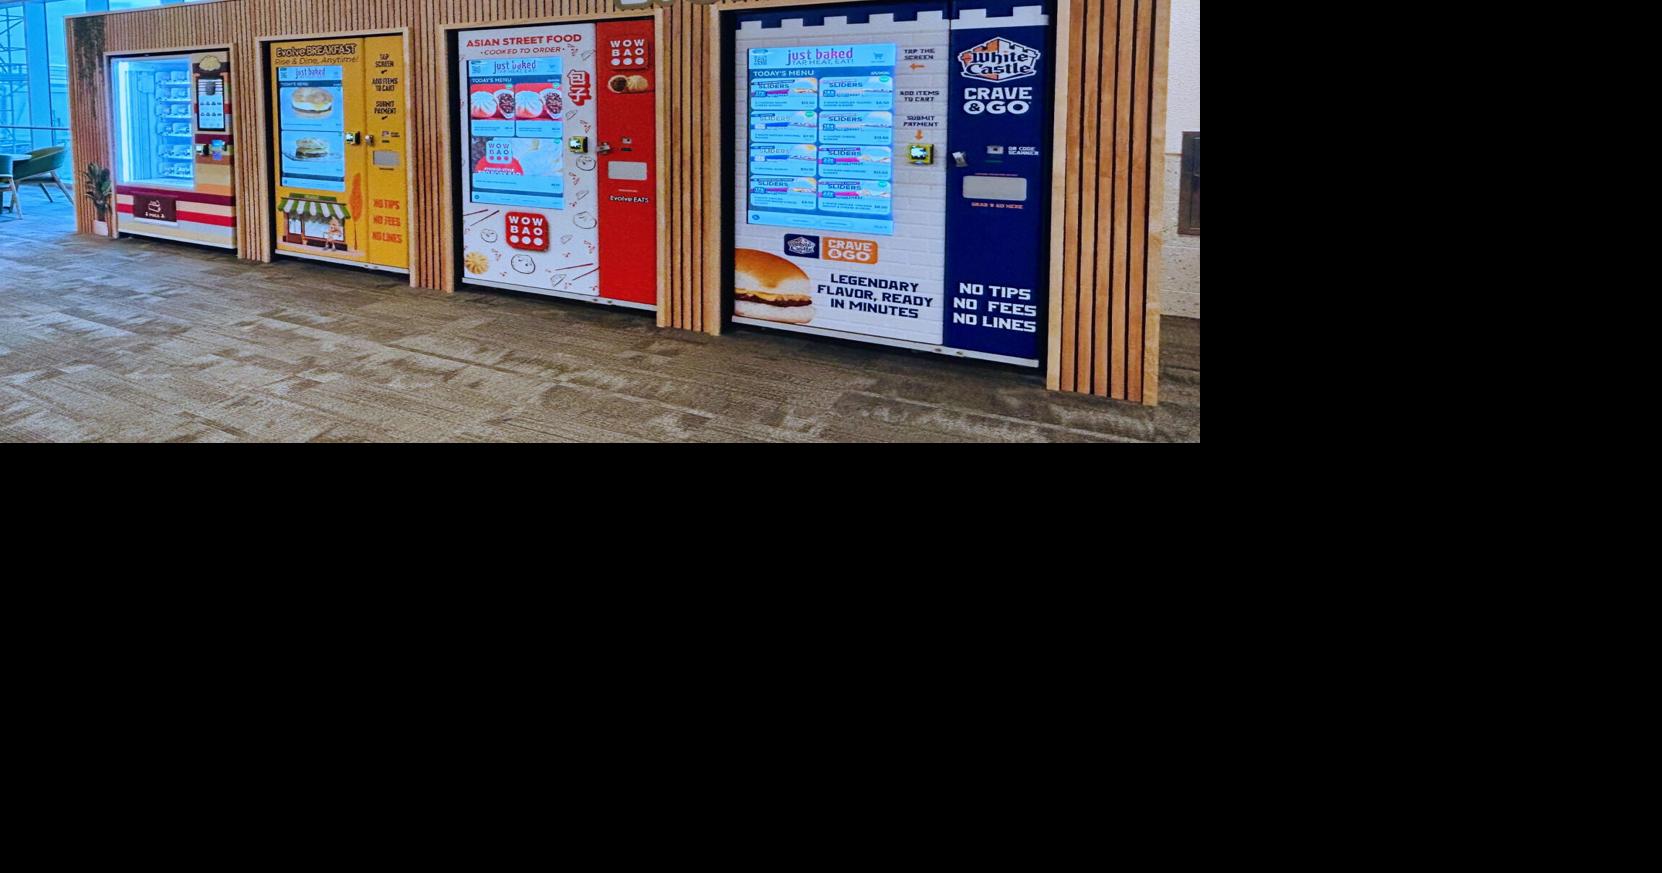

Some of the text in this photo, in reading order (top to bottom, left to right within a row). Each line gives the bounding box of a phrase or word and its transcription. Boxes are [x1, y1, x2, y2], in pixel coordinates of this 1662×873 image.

[466, 34, 582, 48] ASIAN STREET FOOD
[610, 39, 645, 48] WOW
[276, 43, 357, 57] Evolve BREAKFAST
[484, 48, 518, 56] COOKED
[532, 46, 561, 54] ORDER
[611, 48, 645, 57] BAO
[786, 47, 853, 66] just baked
[972, 52, 1030, 64] White
[493, 60, 536, 74] just baked
[966, 63, 1031, 75] Castle
[568, 69, 590, 105] 包子
[964, 87, 1032, 100] CRAVE
[963, 100, 1030, 115] &GO
[374, 200, 400, 210] NO TIPS
[373, 216, 383, 224] NO
[508, 216, 543, 226] WOW
[510, 226, 543, 236] BAO
[828, 239, 873, 252] CRAVE
[830, 273, 919, 292] LEGENDARY
[817, 284, 934, 307] FLAVOR, READY
[960, 282, 1031, 300] NO TIPS
[830, 298, 918, 318] IN MINUTES
[954, 296, 1037, 316] NO FEES
[953, 312, 1037, 332] NO LINES
